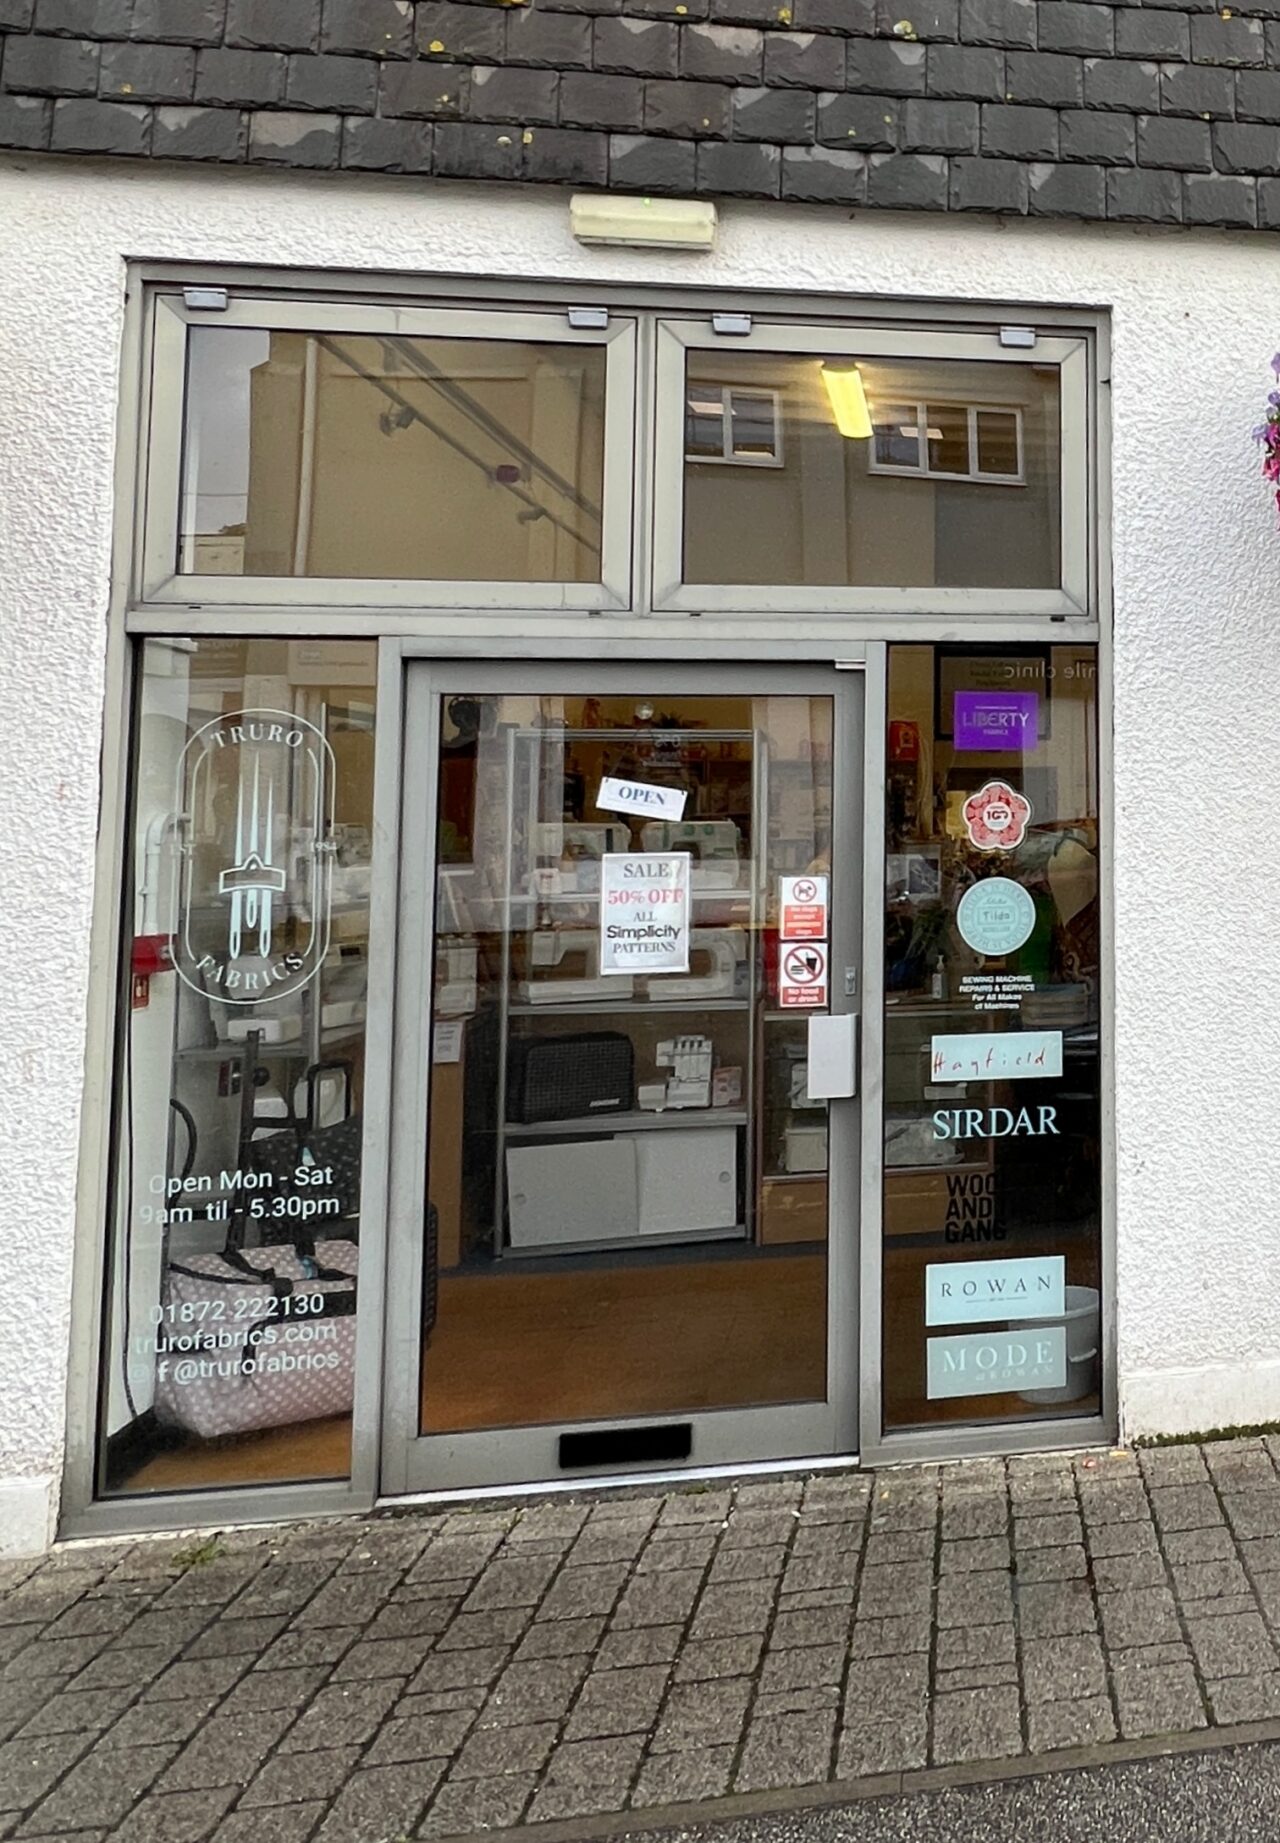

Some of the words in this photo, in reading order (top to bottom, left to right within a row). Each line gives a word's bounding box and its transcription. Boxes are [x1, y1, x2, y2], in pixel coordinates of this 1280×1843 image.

[962, 711, 1030, 727] LIBERTY
[209, 722, 304, 749] TRURO
[618, 786, 666, 806] OPEN
[623, 863, 669, 878] SALE
[608, 890, 645, 905] 50%
[648, 888, 684, 905] OFF
[633, 911, 658, 923] ALL
[607, 925, 681, 941] Simplicity
[612, 942, 676, 954] PATTERNS
[195, 951, 304, 991] FABRICS
[994, 984, 1000, 992] &
[933, 1047, 1045, 1075] Hayfield
[933, 1105, 1060, 1140] SIRDAR
[150, 1173, 212, 1198] Open
[219, 1169, 272, 1191] Mon
[294, 1165, 333, 1186] Sat
[138, 1206, 193, 1227] 9am
[205, 1199, 228, 1222] til
[250, 1196, 340, 1220] 5.30pm
[946, 1197, 993, 1220] AND
[945, 1220, 1007, 1244] GANG
[941, 1275, 1051, 1298] ROWAN
[150, 1300, 226, 1325] 01872
[234, 1294, 325, 1320] 222130
[174, 1350, 340, 1385] @trurofabrics
[943, 1340, 1054, 1373] MODE
